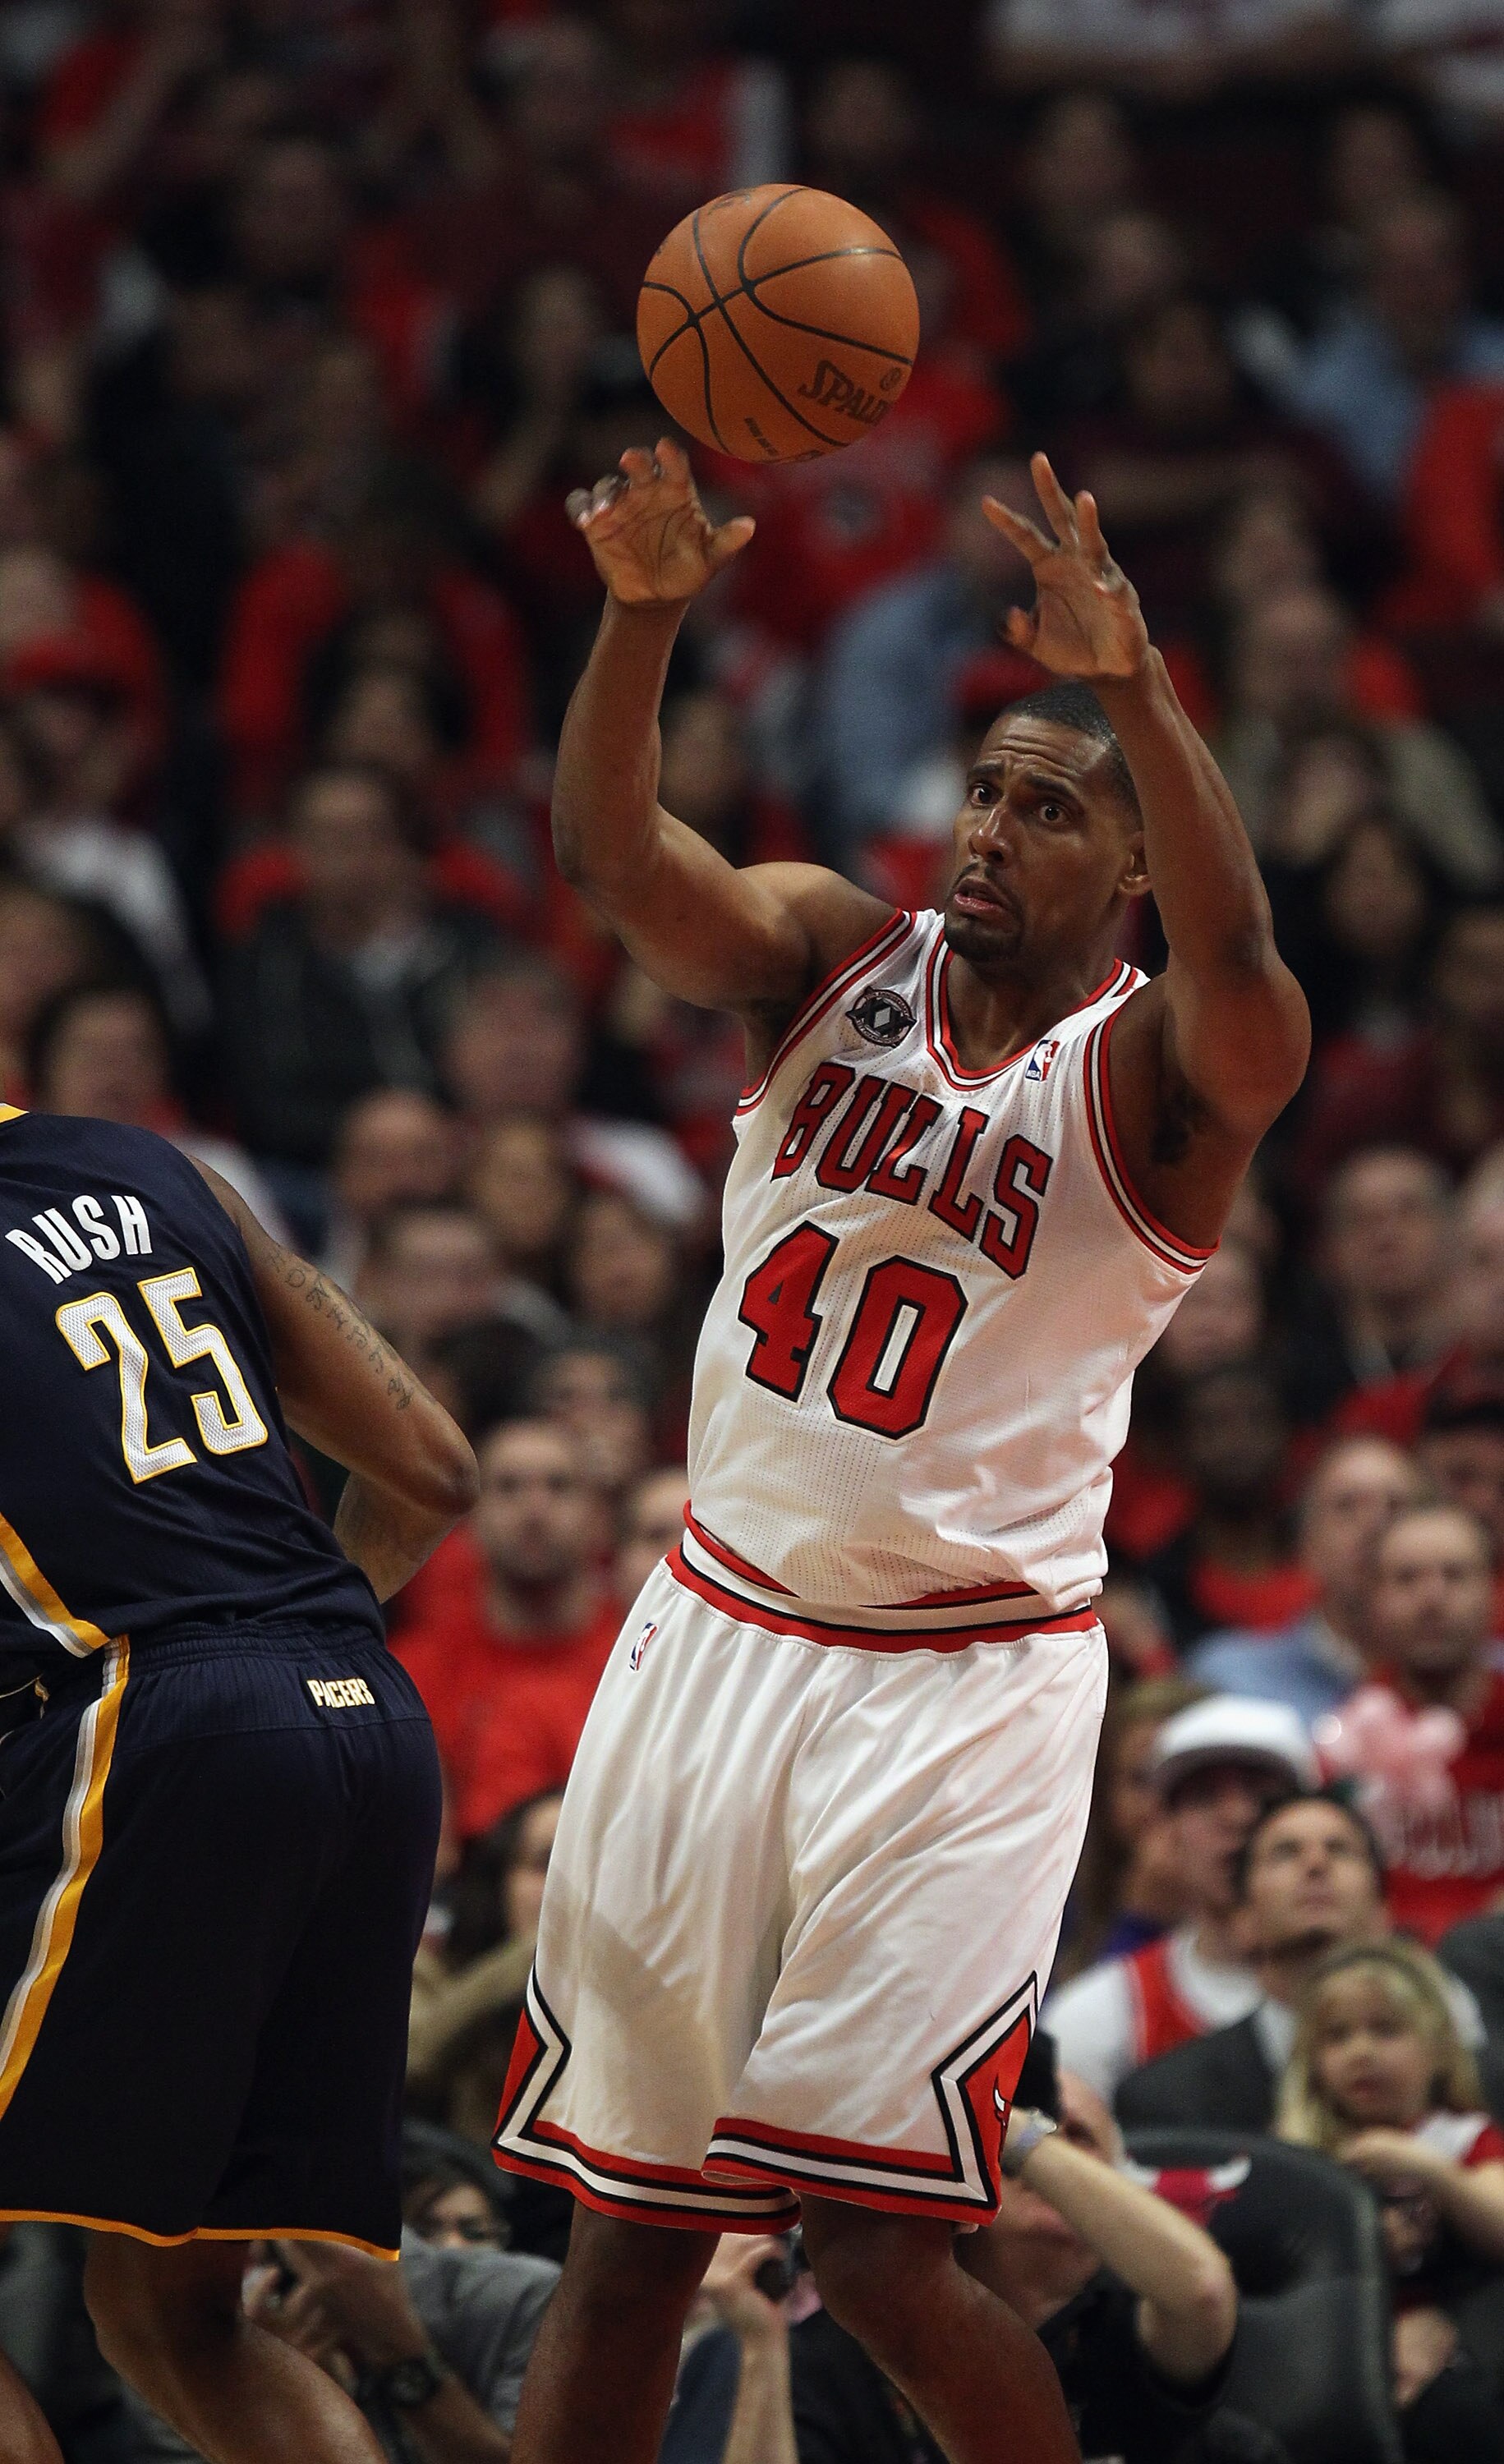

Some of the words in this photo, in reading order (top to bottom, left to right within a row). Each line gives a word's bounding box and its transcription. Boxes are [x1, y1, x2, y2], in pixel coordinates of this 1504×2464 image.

[5, 1195, 153, 1285] RUSH
[771, 1062, 1053, 1280] BULLS
[55, 1266, 268, 1483] 25
[738, 1220, 969, 1441] 40
[306, 1678, 375, 1708] PACERS
